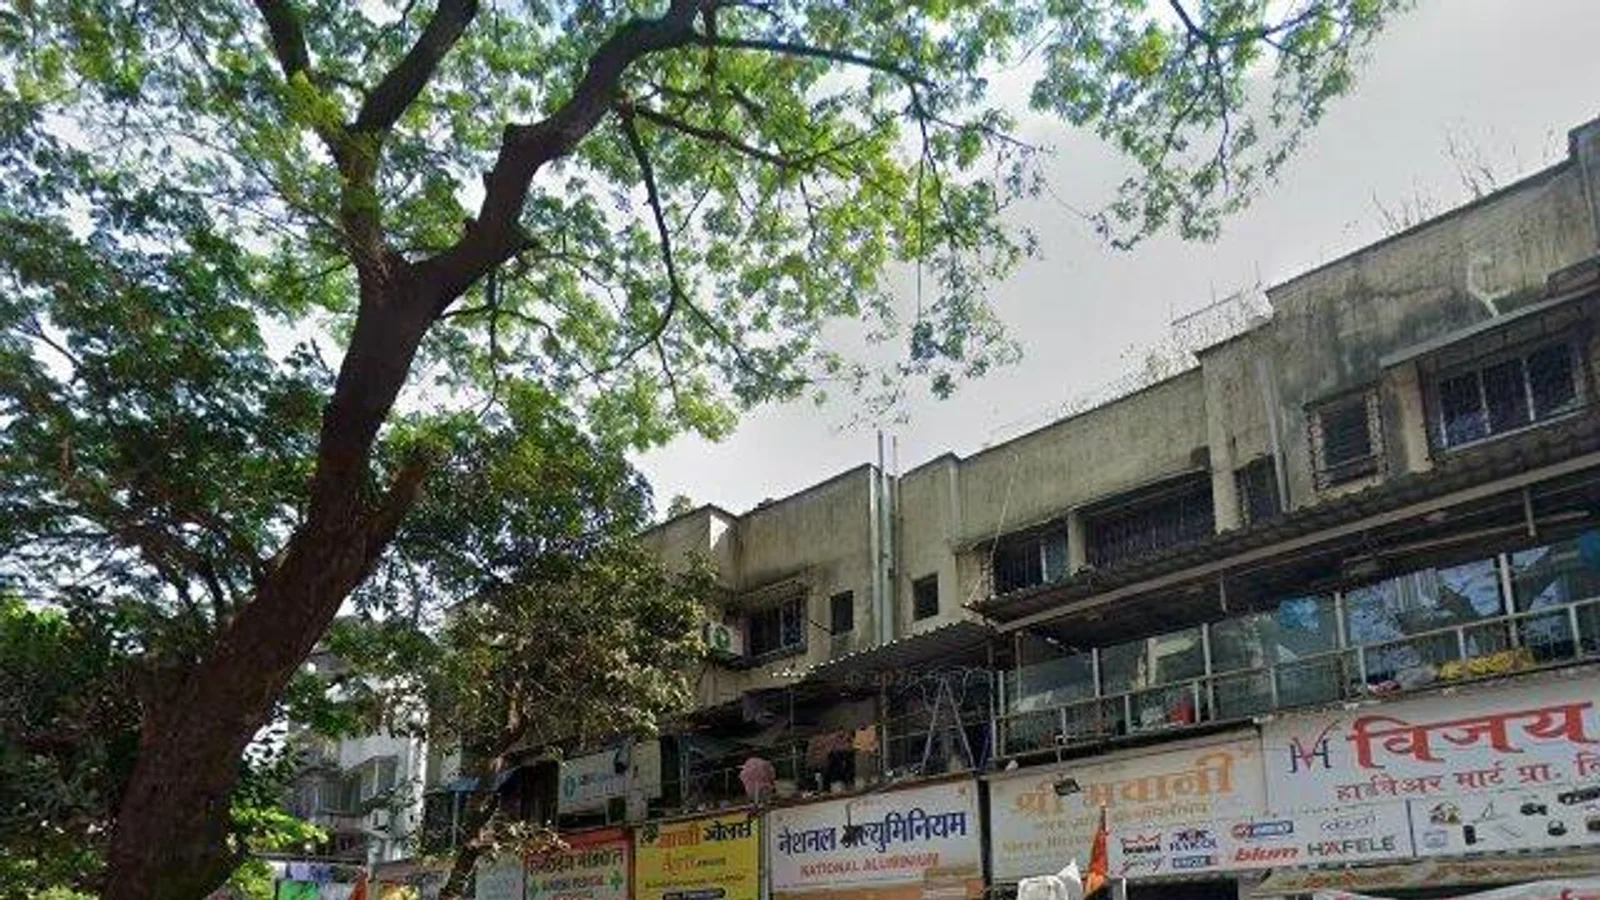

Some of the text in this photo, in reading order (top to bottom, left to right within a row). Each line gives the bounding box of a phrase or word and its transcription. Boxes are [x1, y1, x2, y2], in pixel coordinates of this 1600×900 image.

[1345, 702, 1599, 770] विजय
[777, 824, 836, 855] नेशनल
[1235, 849, 1299, 861] blum
[800, 860, 859, 878] NATIONAL
